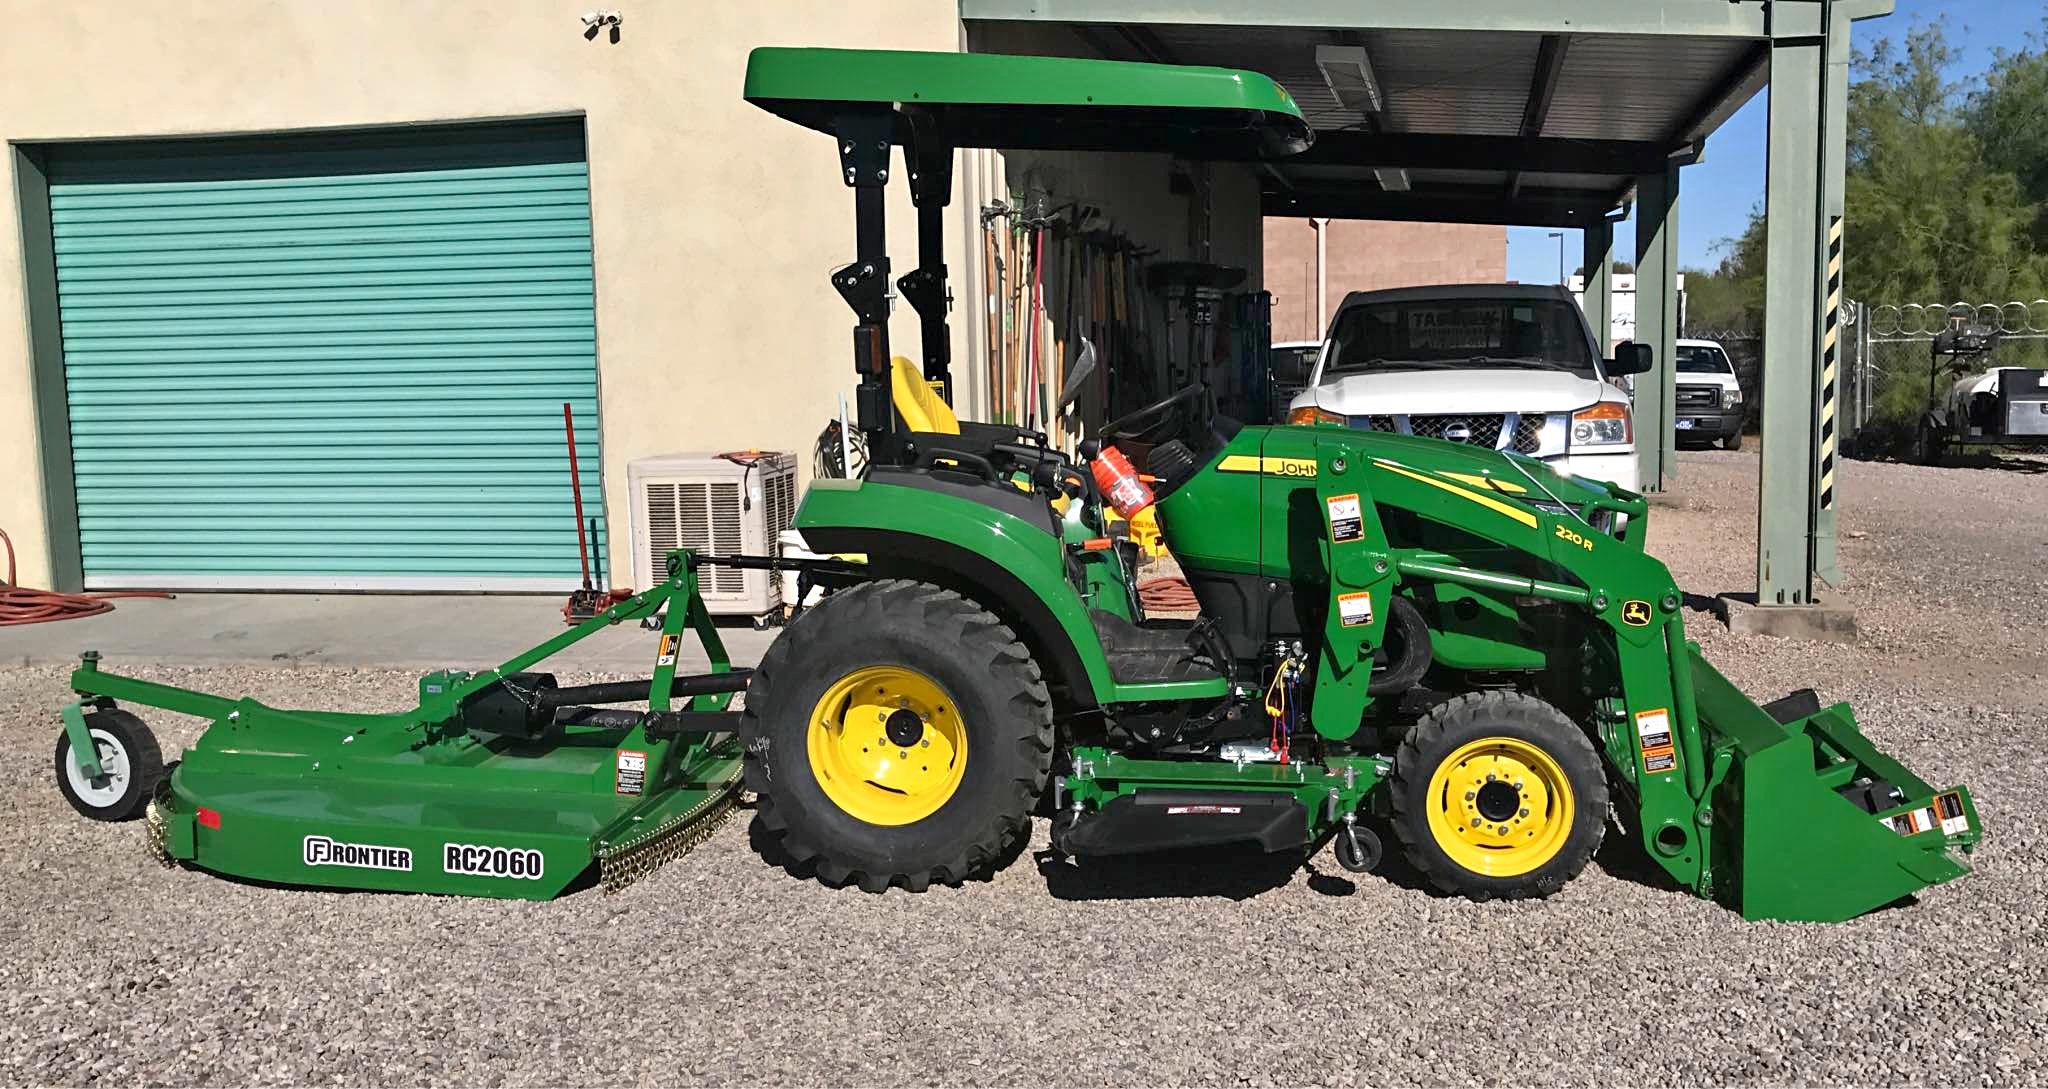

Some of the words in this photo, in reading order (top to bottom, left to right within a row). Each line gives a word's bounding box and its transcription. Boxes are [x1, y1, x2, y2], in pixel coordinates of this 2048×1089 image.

[1277, 461, 1317, 475] JOHN
[1556, 524, 1582, 545] 220
[1584, 539, 1593, 551] R
[306, 838, 410, 869] FRONTIER
[446, 846, 541, 877] RC2060
